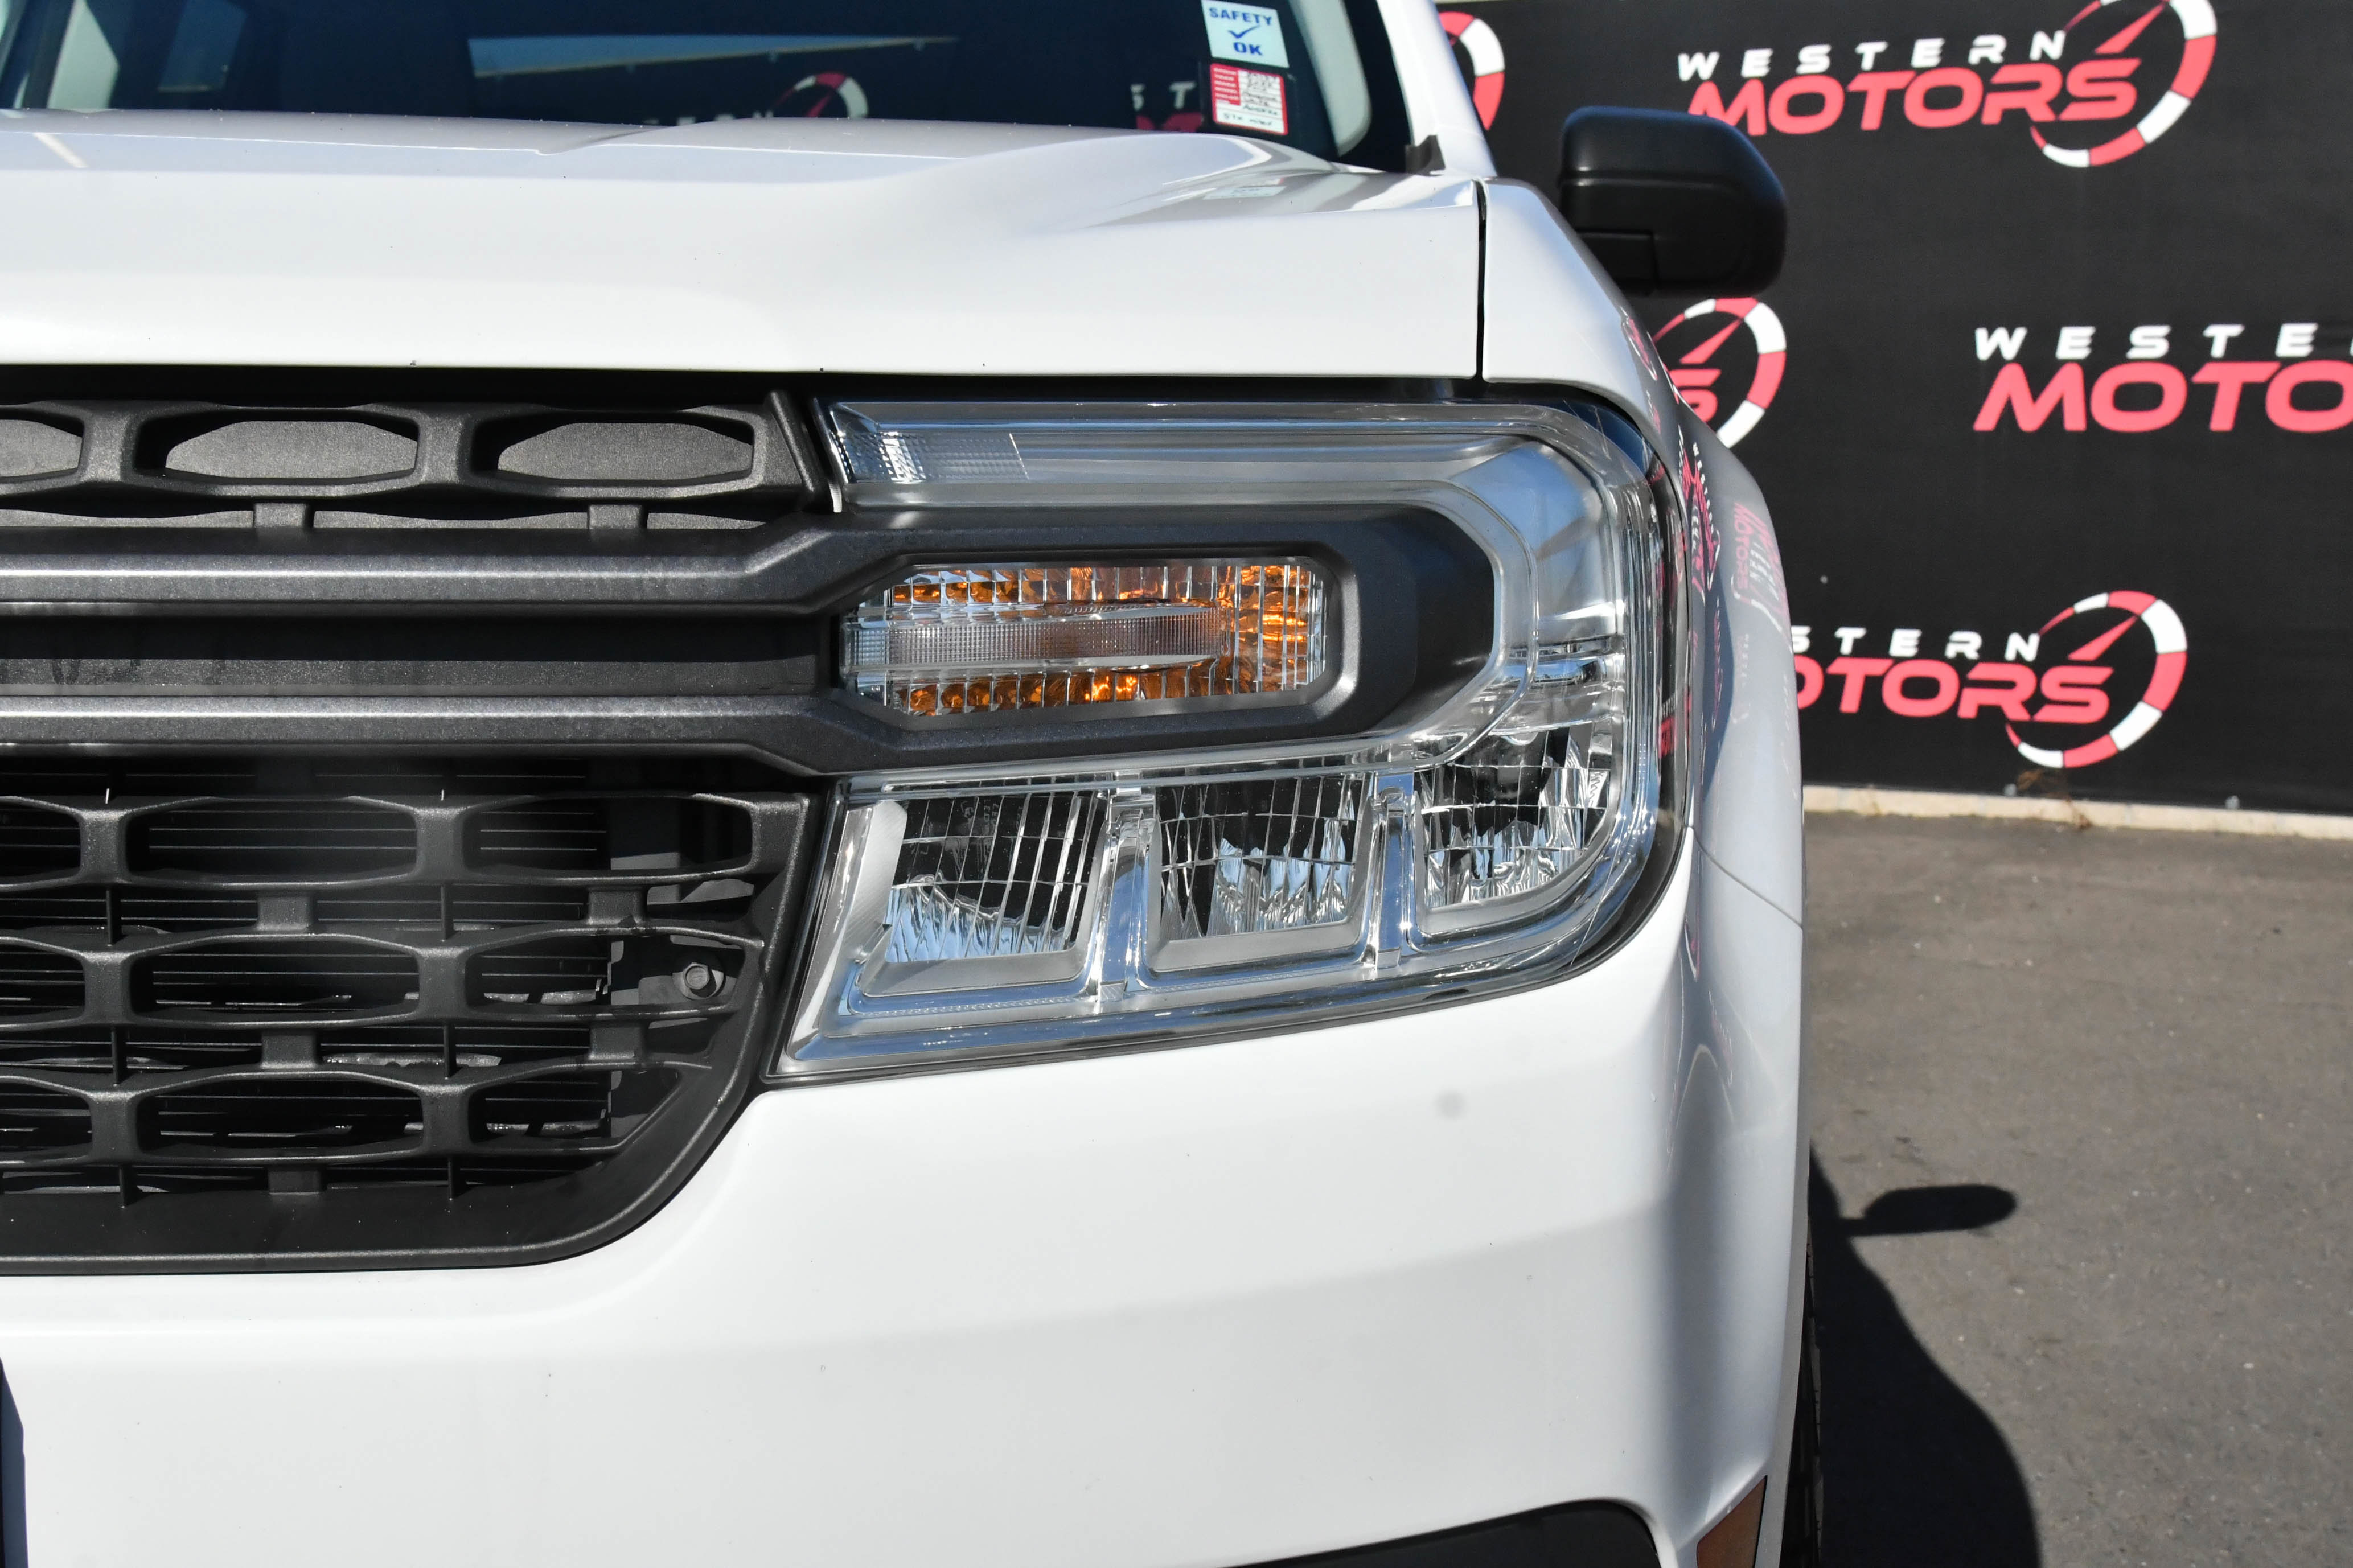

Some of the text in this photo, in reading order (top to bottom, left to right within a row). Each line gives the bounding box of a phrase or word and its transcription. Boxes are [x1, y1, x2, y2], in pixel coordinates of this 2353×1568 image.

[1209, 7, 1272, 26] SAFETY
[1233, 42, 1263, 56] OK
[1678, 30, 2065, 81] WESTERN
[1688, 57, 2141, 136] MOTORS
[1975, 322, 2353, 361] WESTE
